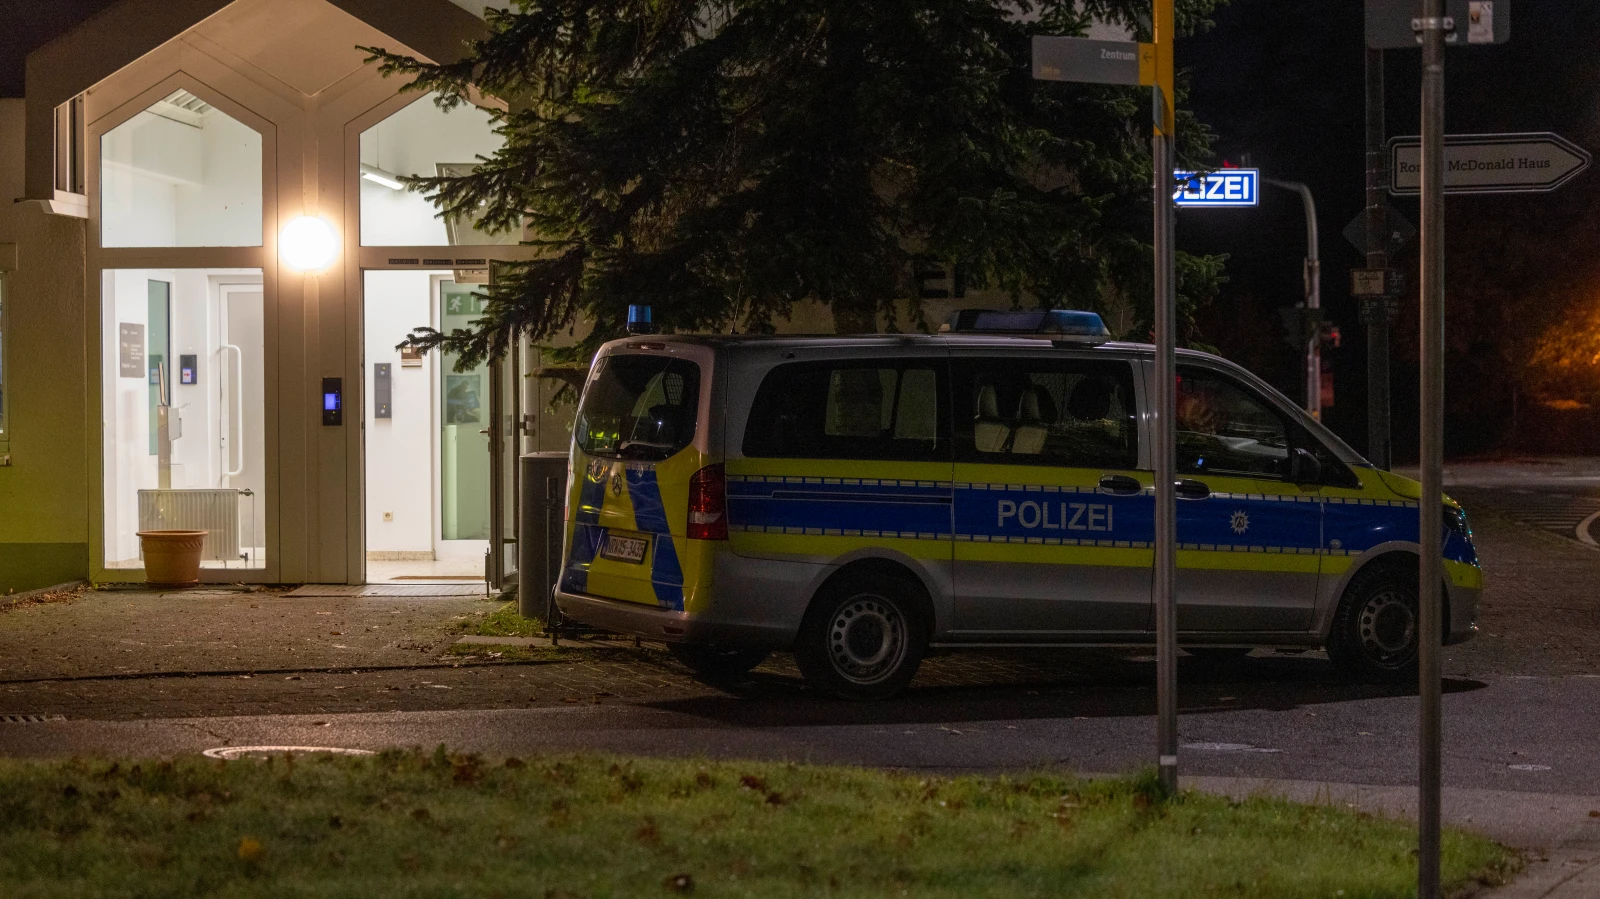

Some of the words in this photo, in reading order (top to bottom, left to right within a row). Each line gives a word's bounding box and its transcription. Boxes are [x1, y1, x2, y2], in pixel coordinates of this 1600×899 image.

[1100, 48, 1136, 61] Zentrum
[1448, 158, 1515, 172] McDonald
[1518, 157, 1551, 169] Haus
[1172, 176, 1249, 200] LIZEI
[997, 499, 1113, 532] POLIZEI
